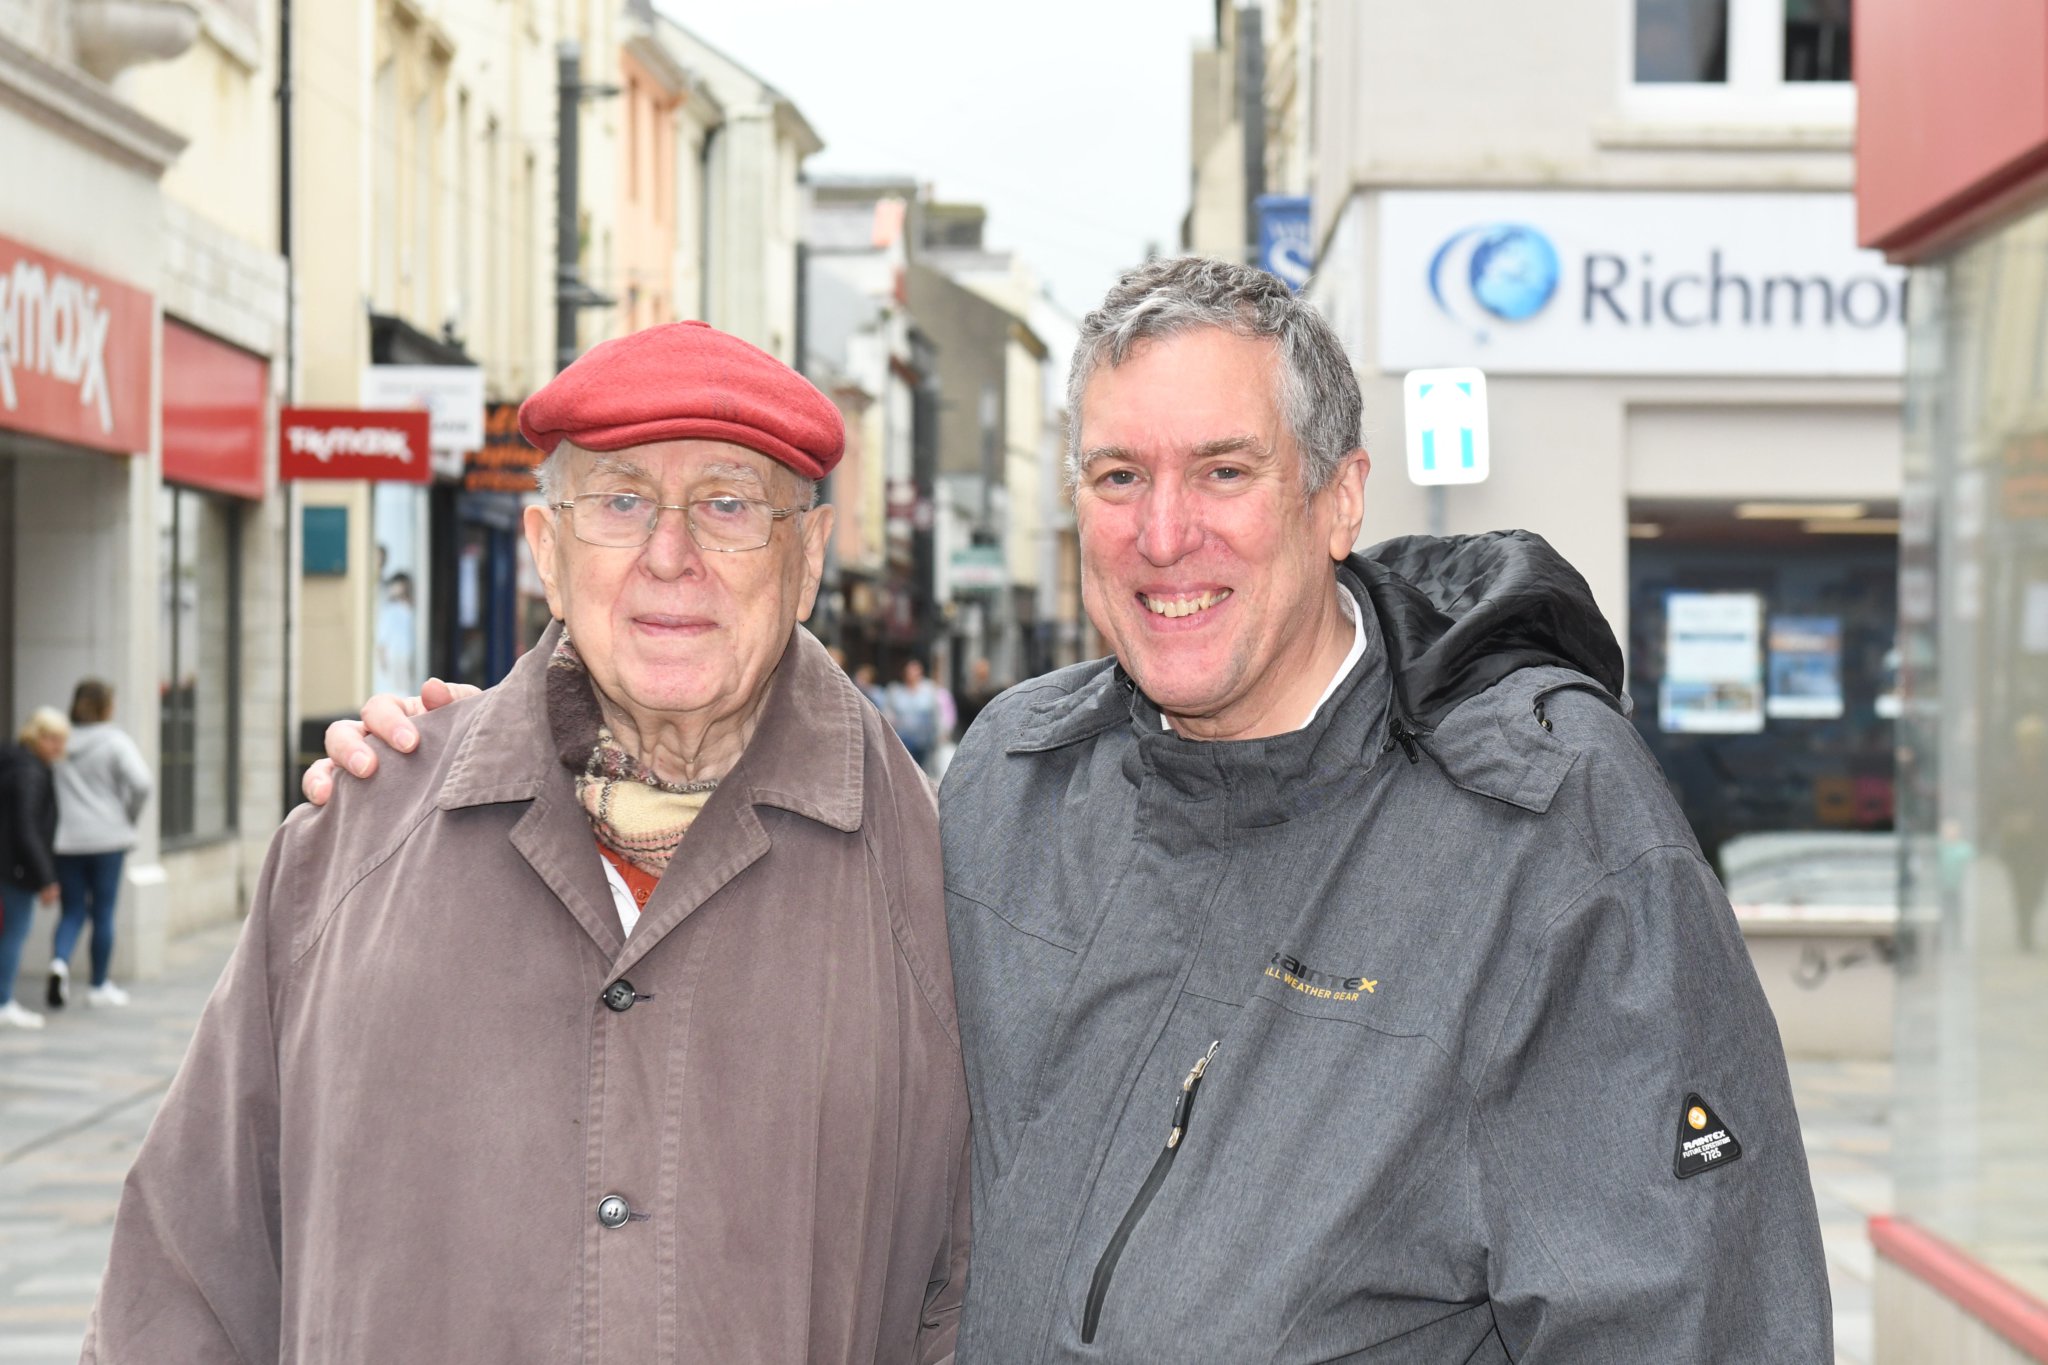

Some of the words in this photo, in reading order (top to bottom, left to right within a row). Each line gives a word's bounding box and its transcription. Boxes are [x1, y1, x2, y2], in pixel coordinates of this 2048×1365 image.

[1284, 973, 1331, 999] WEATHER
[1333, 991, 1359, 1002] GEAR
[1683, 1130, 1726, 1151] RAINTEX
[1682, 1147, 1702, 1159] FUTURE
[1701, 1147, 1722, 1162] 7725
